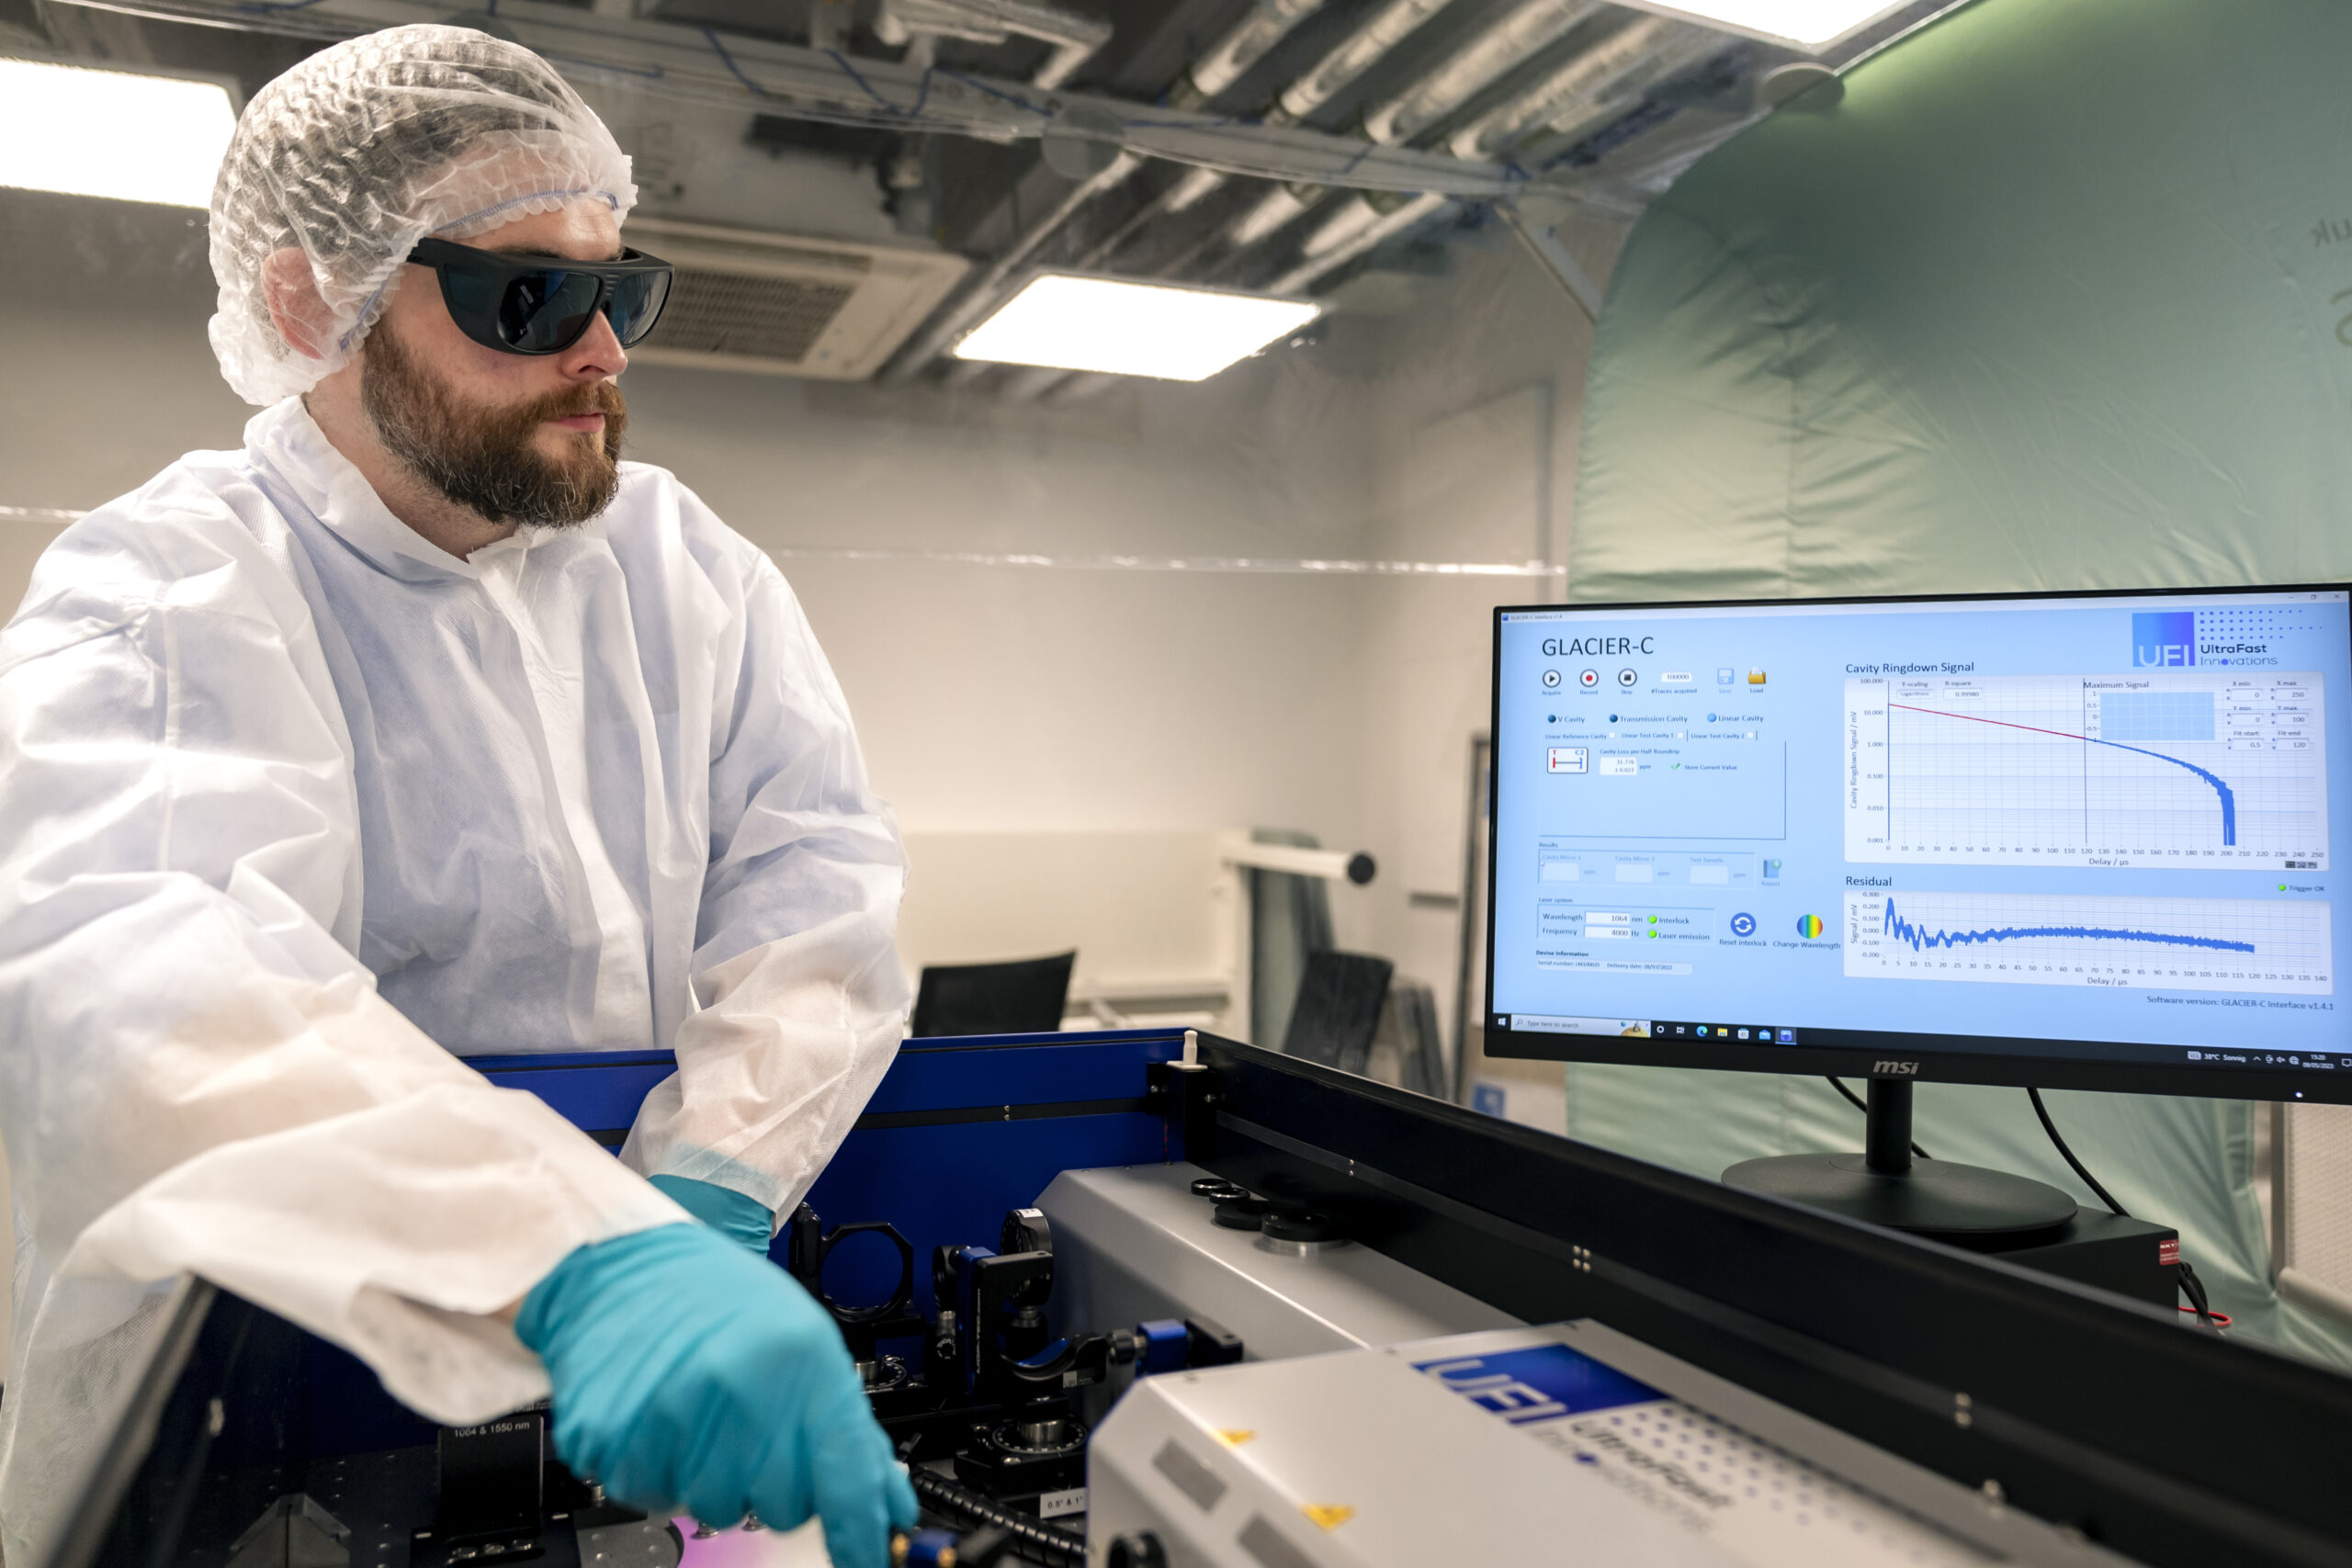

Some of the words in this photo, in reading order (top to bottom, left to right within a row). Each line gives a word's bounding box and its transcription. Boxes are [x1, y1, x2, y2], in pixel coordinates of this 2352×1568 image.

[1542, 637, 1654, 657] GLACIER-C
[2200, 644, 2267, 654] UltraFast
[2139, 644, 2189, 667] UFI
[2200, 655, 2278, 666] Innovations
[1846, 663, 1879, 674] Cavity
[1883, 662, 1938, 674] Ringdown
[1940, 662, 1974, 673] Signal
[2125, 681, 2149, 690] Signal
[1742, 715, 1764, 723] Cavity
[1850, 711, 1858, 723] mV
[1849, 728, 1859, 750] Signal
[1849, 750, 1859, 786] Ringdown
[1849, 787, 1859, 809] Cavity
[2088, 858, 2111, 866] Delay
[1846, 875, 1893, 886] Residual
[2290, 885, 2313, 893] Trigger
[1850, 904, 1858, 917] mV
[1543, 913, 1583, 922] Wavelength
[1658, 917, 1690, 925] Interlock
[1543, 927, 1577, 936] Frequency
[1850, 922, 1860, 943] Signal
[1772, 941, 1799, 949] Change
[1801, 942, 1841, 950] Wavelength
[2087, 976, 2109, 986] Delay
[2146, 995, 2184, 1005] Software
[2186, 998, 2219, 1007] version:
[2221, 998, 2266, 1008] GLACIER-C
[2267, 1000, 2306, 1010] Interface
[2309, 1002, 2334, 1010] v1.4.1
[2222, 1054, 2247, 1063] Sonnig
[1873, 1060, 1919, 1075] msi
[1425, 1359, 1567, 1421] UFI
[454, 1427, 477, 1438] 1064
[480, 1426, 487, 1435] &
[491, 1423, 513, 1434] 1550
[514, 1422, 530, 1430] nm
